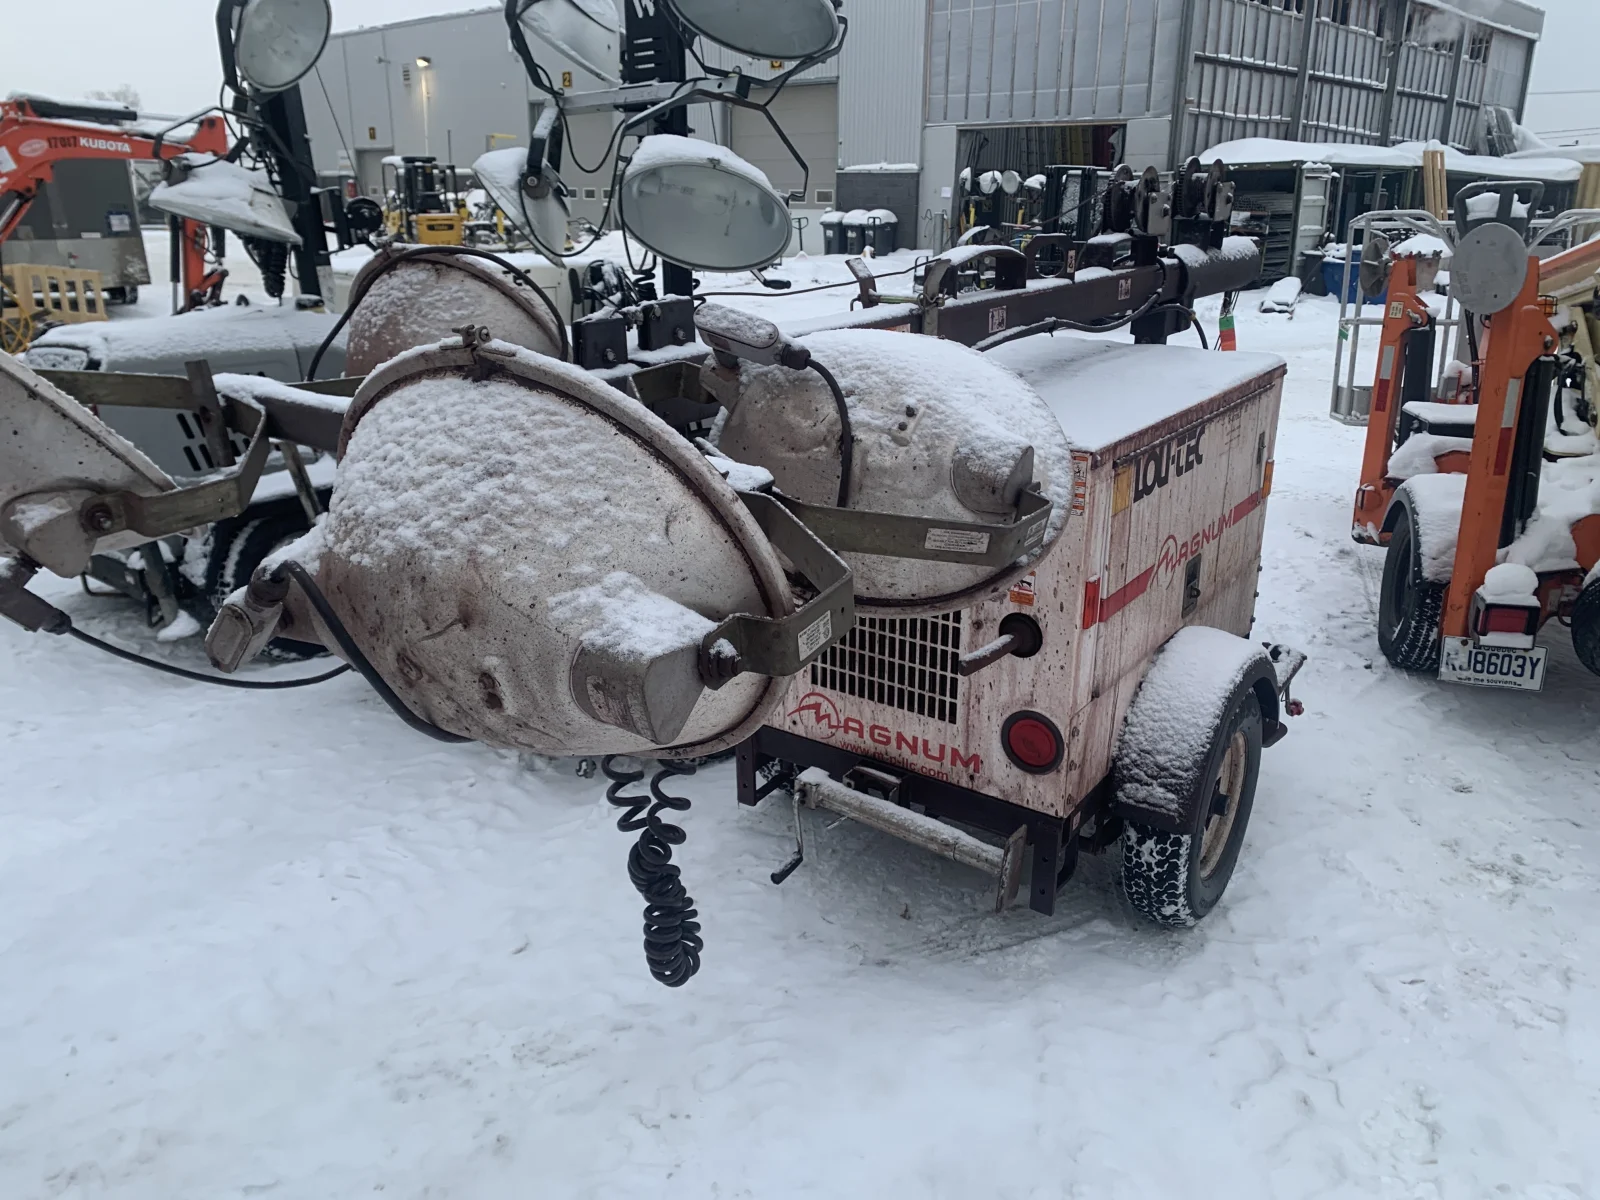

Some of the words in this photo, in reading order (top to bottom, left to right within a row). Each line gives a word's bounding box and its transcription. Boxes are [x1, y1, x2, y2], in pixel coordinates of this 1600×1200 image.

[80, 136, 132, 153] KUBOTA
[1133, 424, 1206, 504] LOU-TEC
[1150, 508, 1233, 591] MAGNUM
[1486, 678, 1517, 687] souviens
[787, 692, 981, 774] MAGNUM
